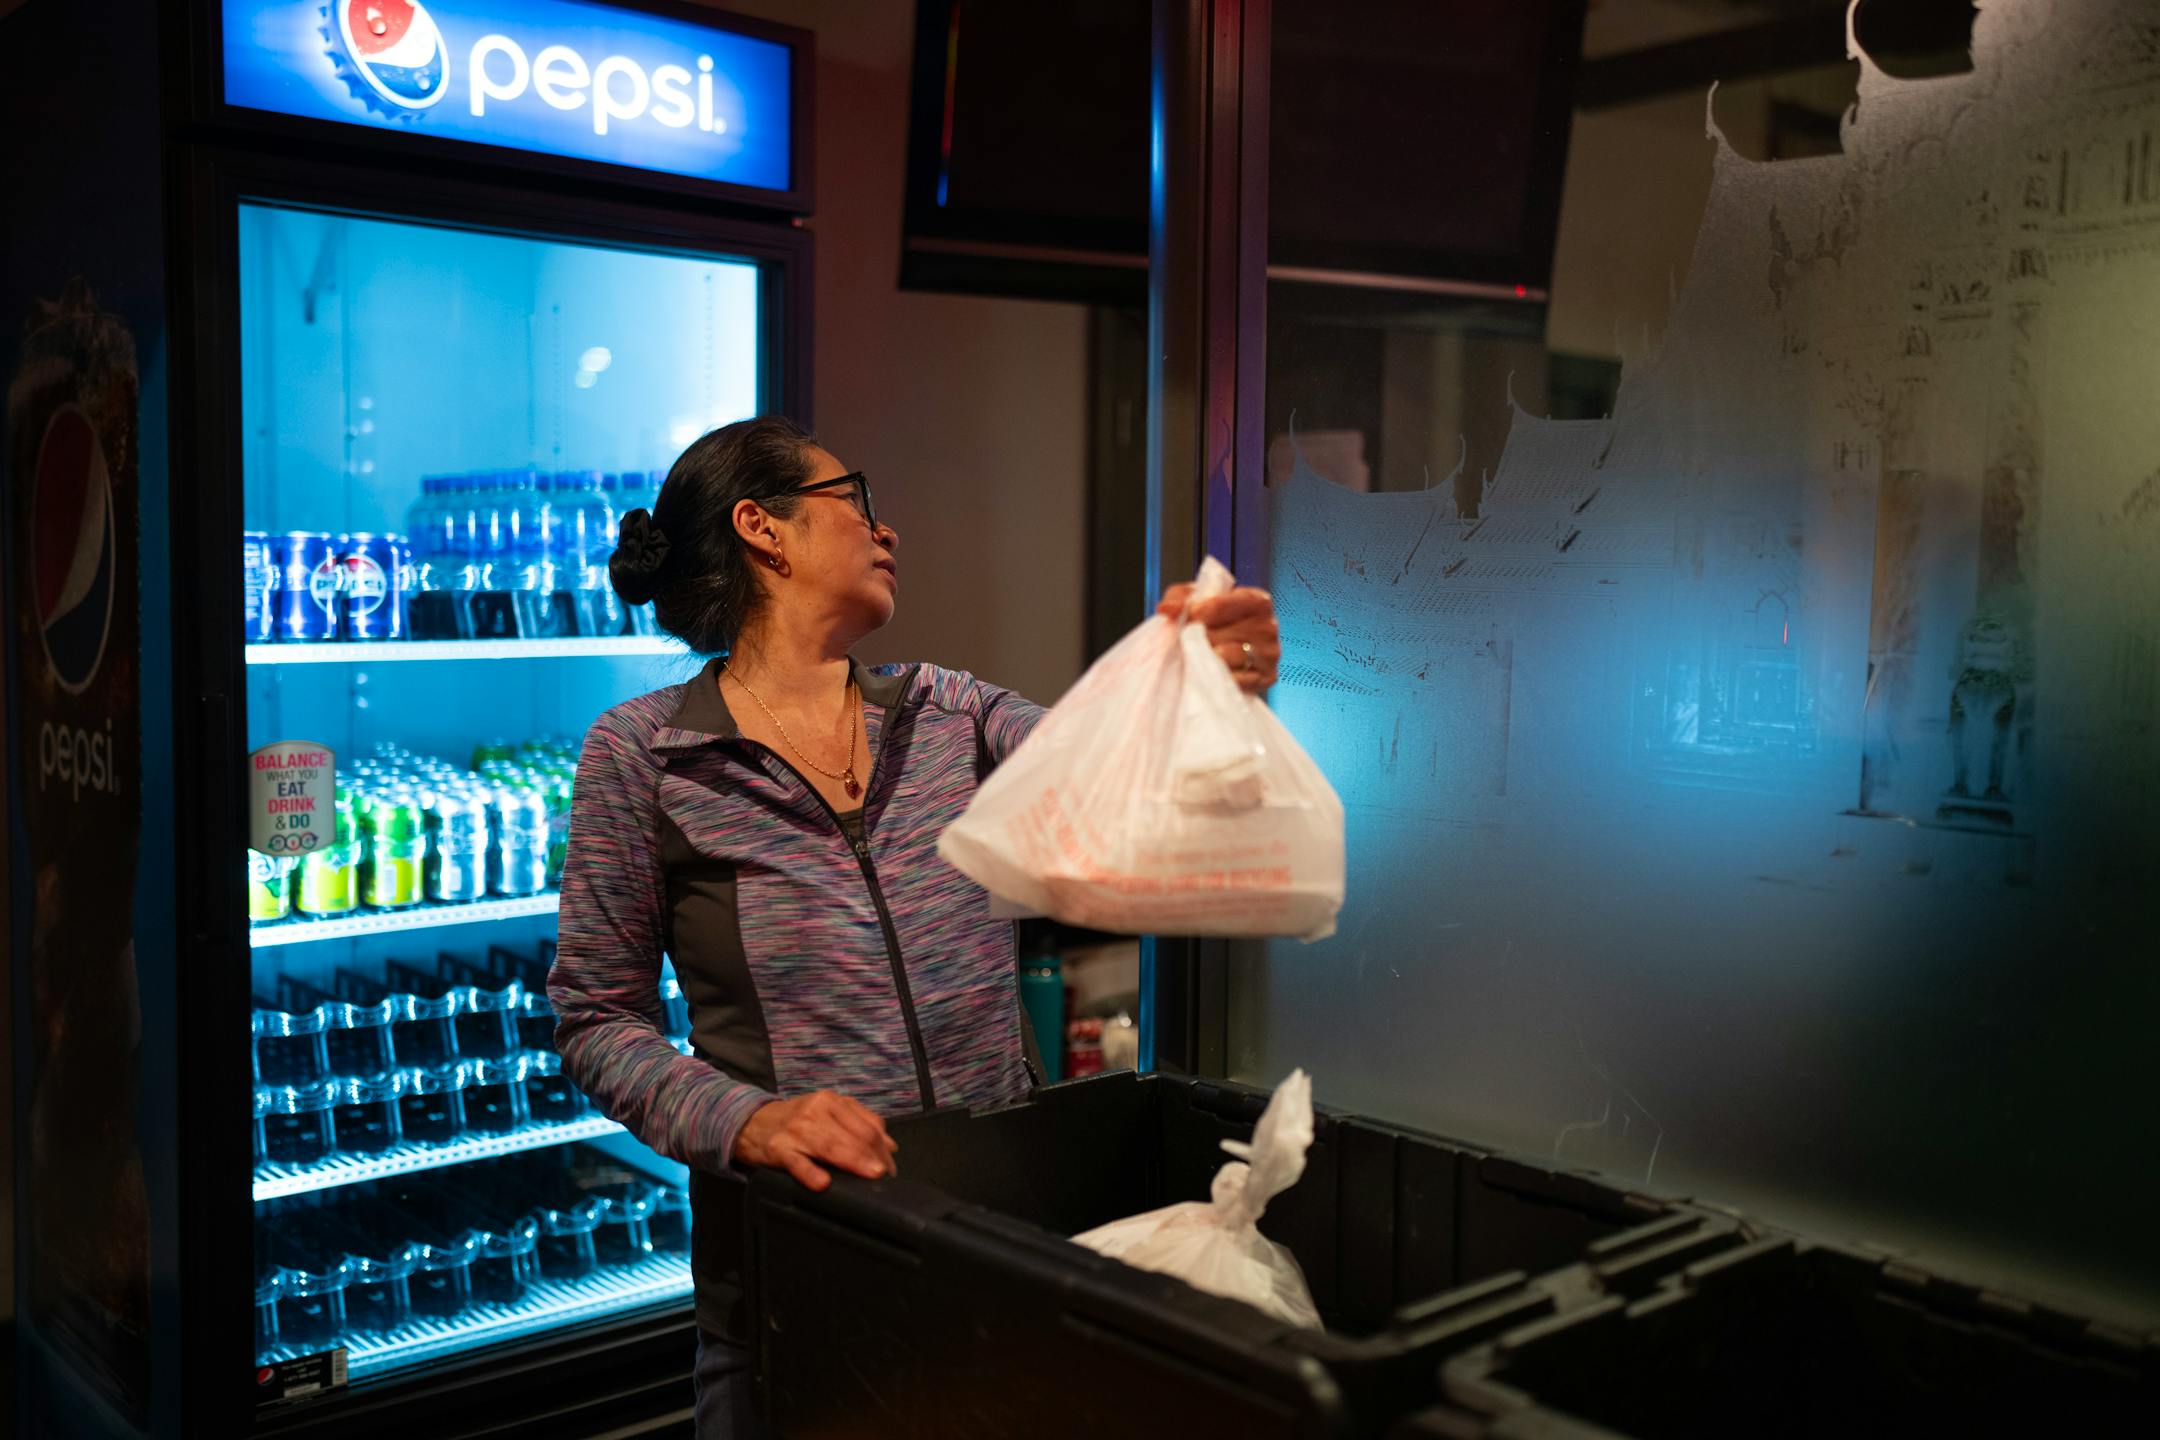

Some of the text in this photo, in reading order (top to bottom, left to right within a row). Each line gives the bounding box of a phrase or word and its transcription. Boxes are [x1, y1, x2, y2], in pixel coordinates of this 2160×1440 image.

[469, 34, 714, 136] pepsi
[41, 717, 113, 803] pepsi
[255, 752, 328, 770] BALANCE
[266, 769, 318, 781] WHAT YOU
[268, 797, 316, 815] DRINK
[275, 813, 311, 830] & DO
